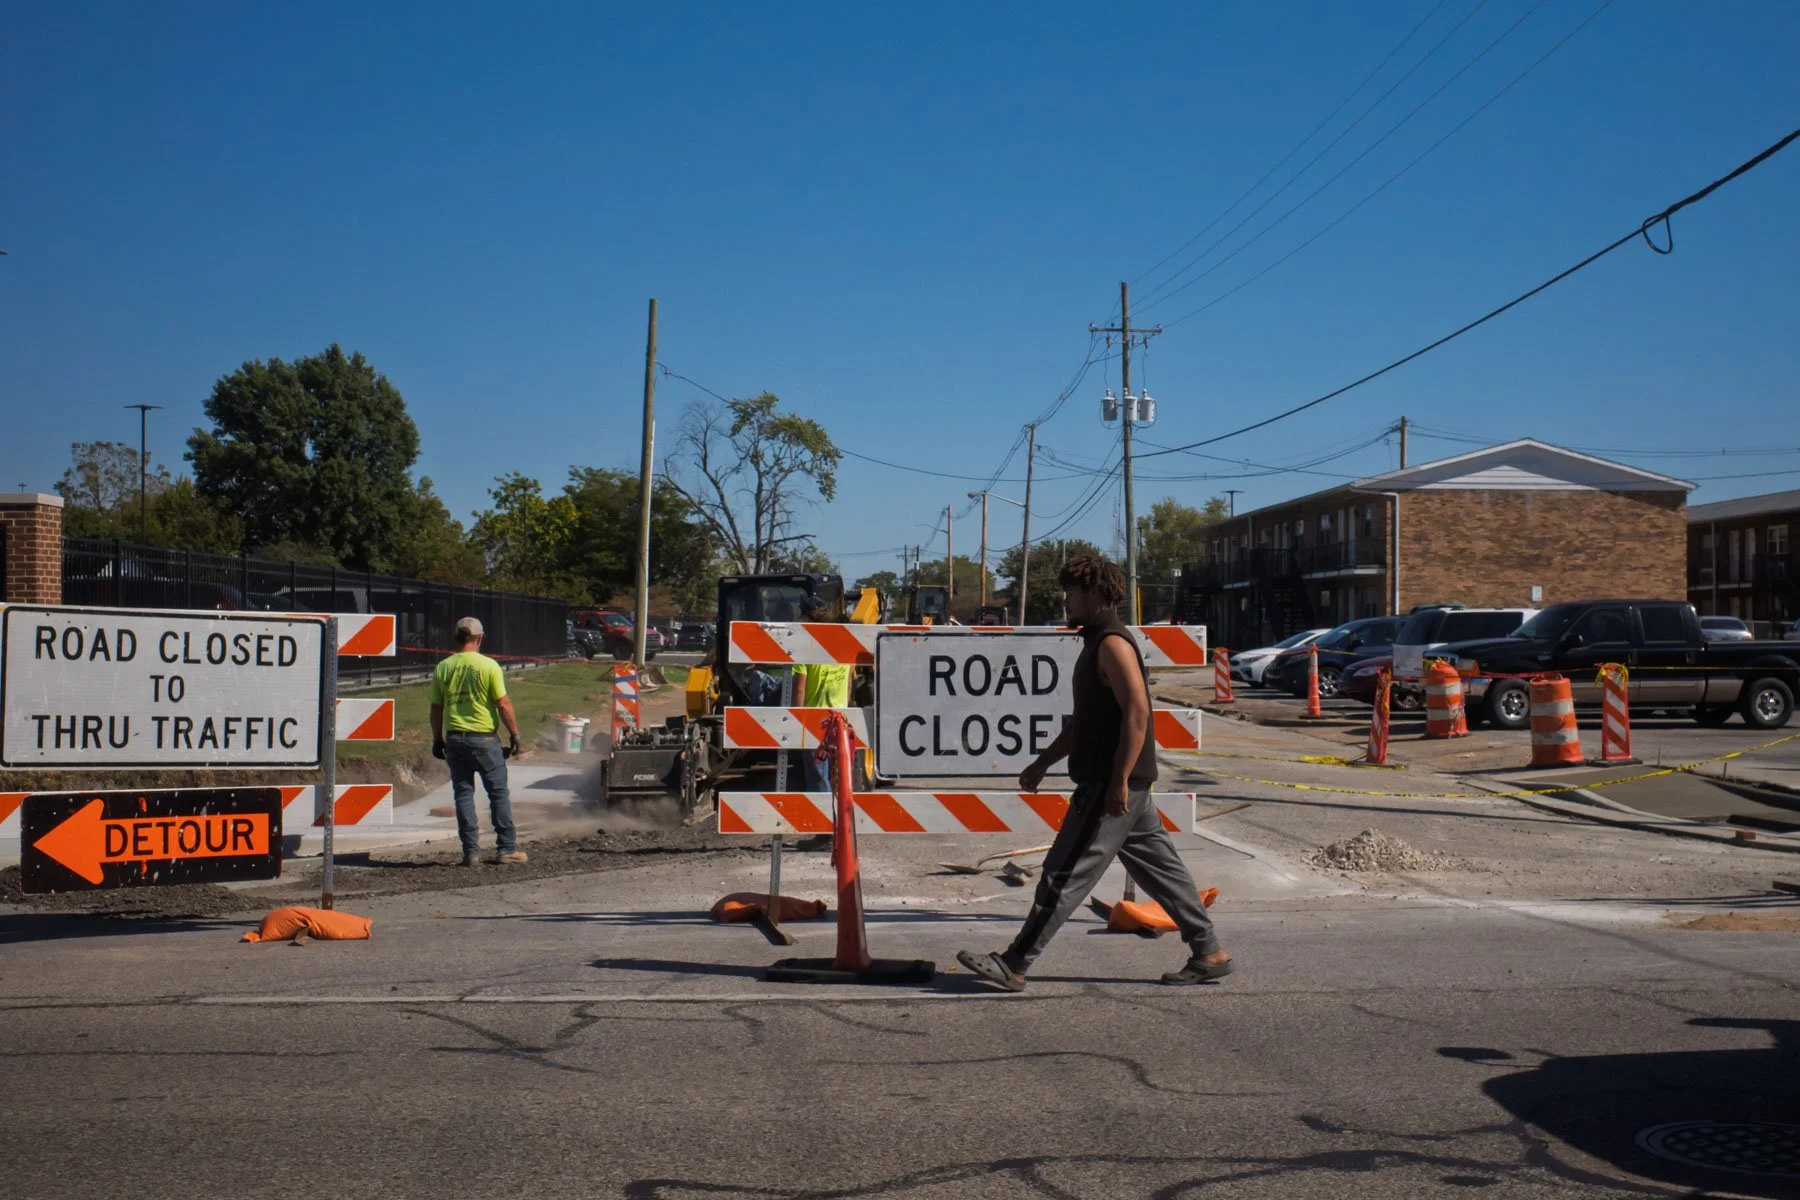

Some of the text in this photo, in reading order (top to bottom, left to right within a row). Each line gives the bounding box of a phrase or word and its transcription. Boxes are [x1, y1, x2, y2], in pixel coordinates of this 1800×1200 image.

[36, 626, 297, 667] ROAD CLOSED
[150, 675, 185, 703] TO
[929, 654, 1060, 697] ROAD
[32, 715, 298, 750] THRU TRAFFIC
[899, 714, 1074, 757] CLOSE
[106, 819, 255, 858] DETOUR
